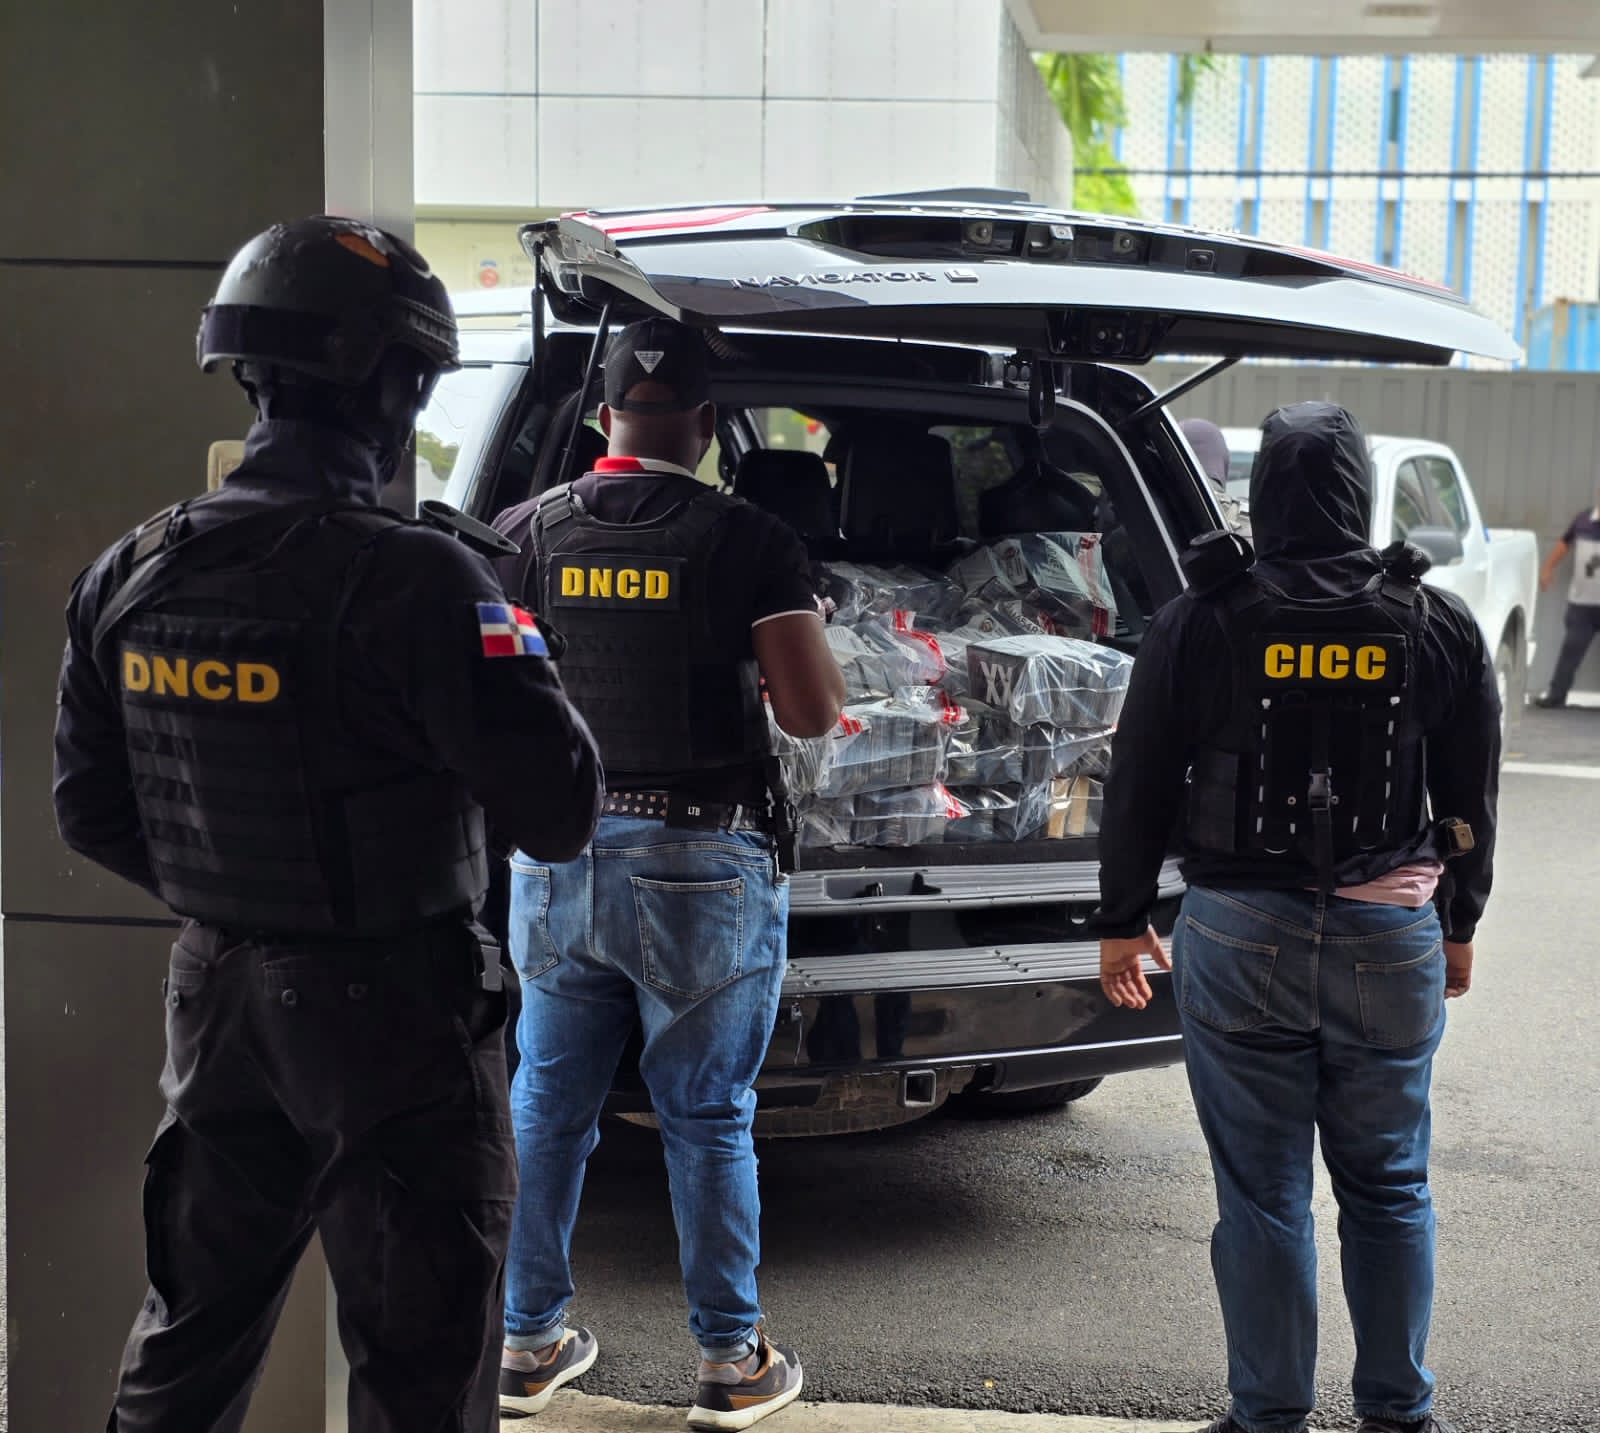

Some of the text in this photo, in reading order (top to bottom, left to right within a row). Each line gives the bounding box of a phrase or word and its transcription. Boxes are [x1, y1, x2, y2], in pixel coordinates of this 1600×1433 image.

[729, 266, 979, 289] NAVIGATOR L
[561, 567, 670, 599] DNCD
[123, 651, 281, 703] DNCD
[1264, 643, 1387, 681] CICC
